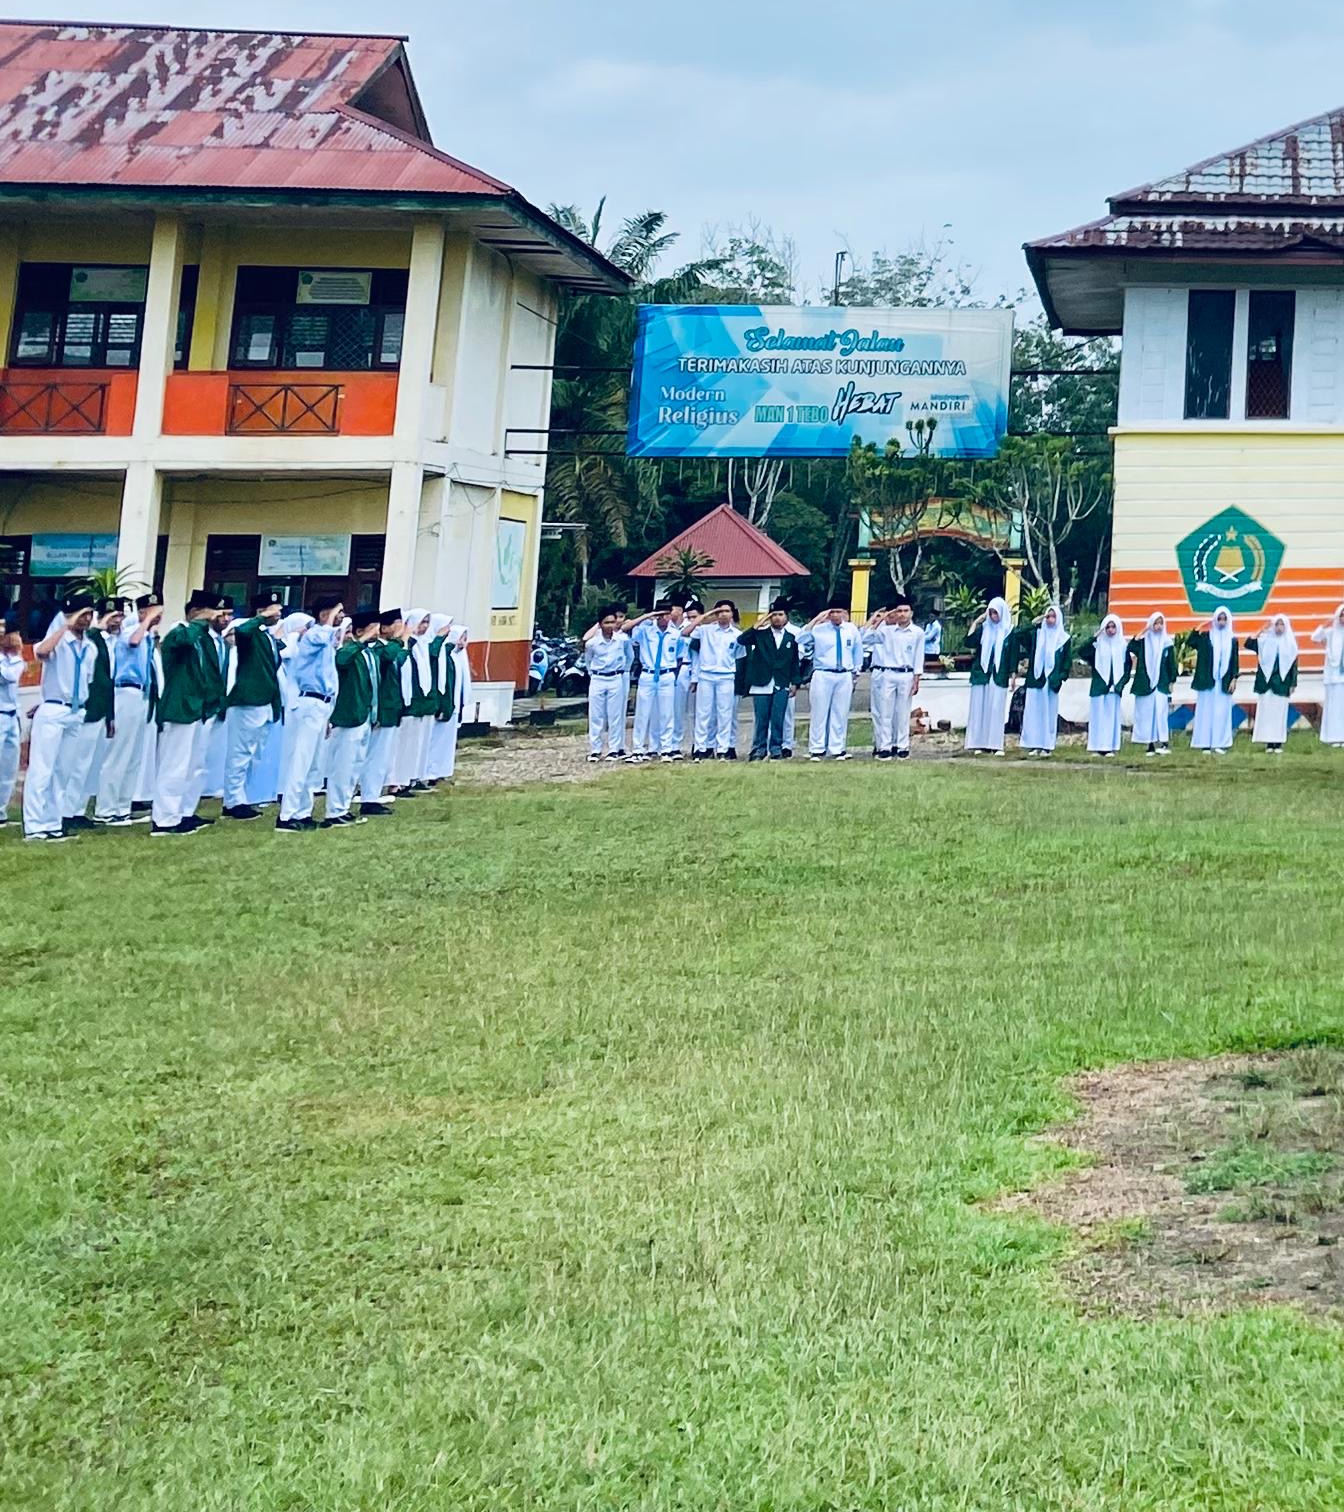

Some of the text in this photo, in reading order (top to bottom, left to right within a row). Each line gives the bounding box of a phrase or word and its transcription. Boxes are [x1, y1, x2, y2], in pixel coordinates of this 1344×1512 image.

[744, 326, 904, 356] Selamat Jalan
[678, 356, 967, 377] TERIMAKASIH ATAS KUNJUNGANNYA
[660, 386, 726, 402] Modern
[831, 381, 902, 425] HEBAT
[754, 405, 829, 424] MAN 1 TEBO
[910, 401, 966, 411] MANDIRI
[657, 406, 740, 430] Religius
